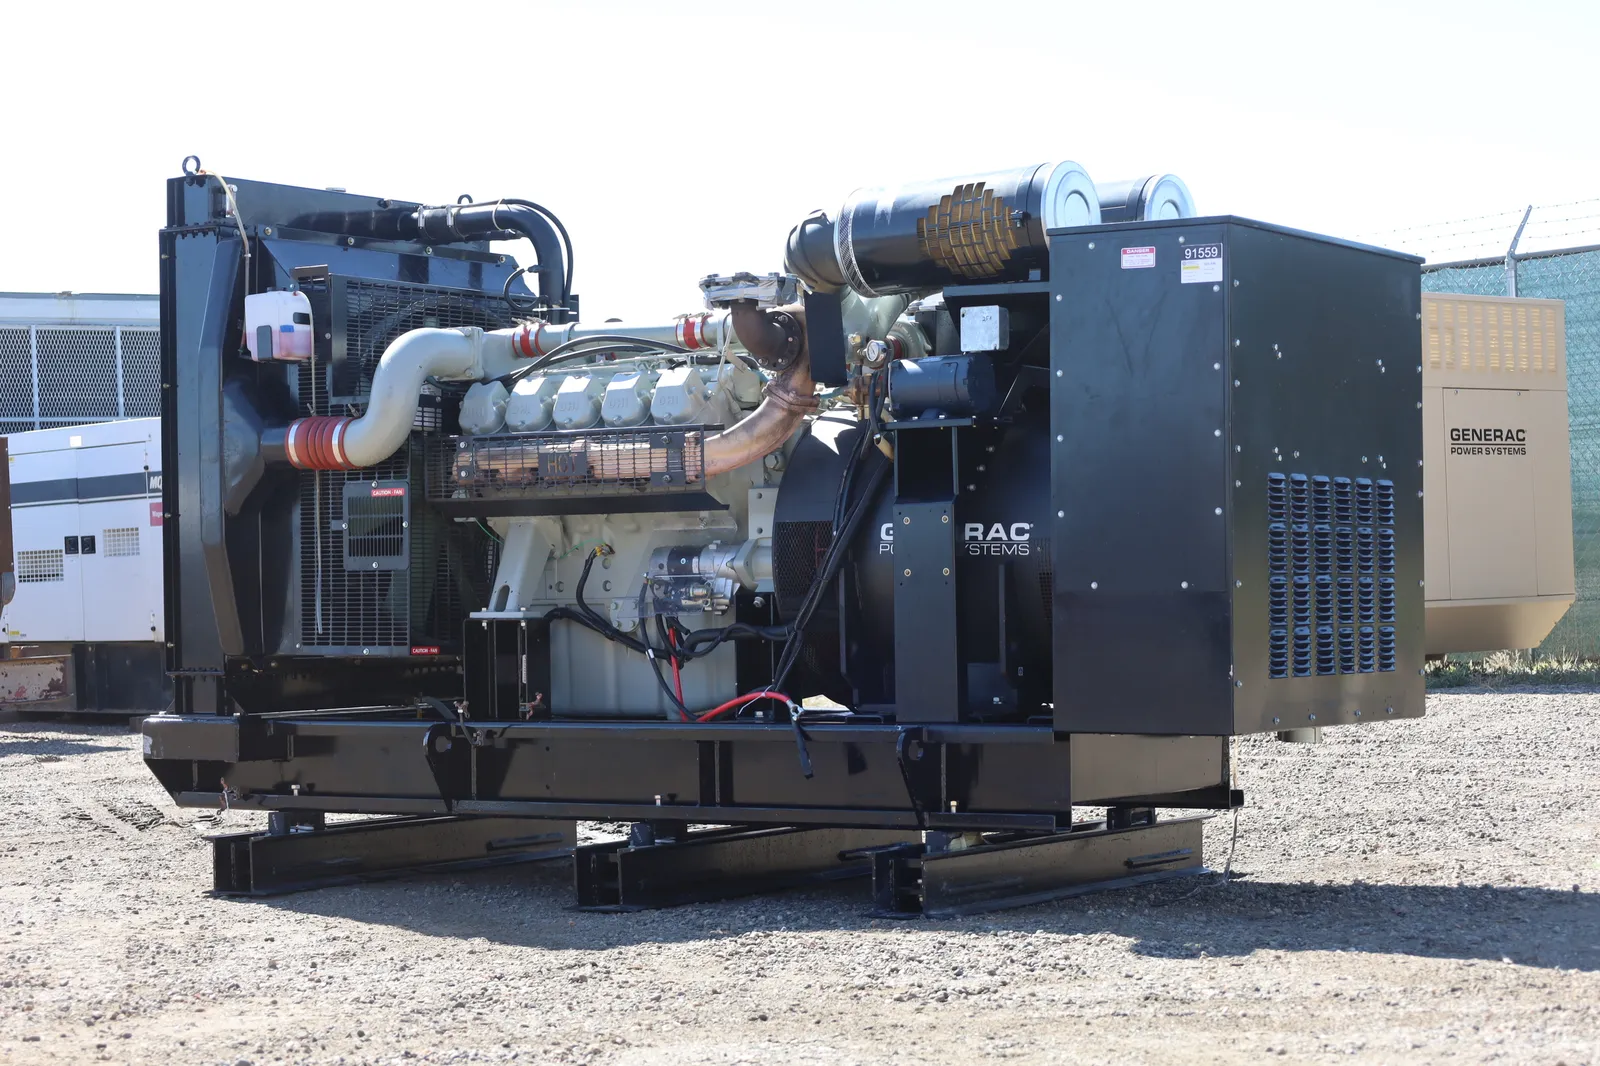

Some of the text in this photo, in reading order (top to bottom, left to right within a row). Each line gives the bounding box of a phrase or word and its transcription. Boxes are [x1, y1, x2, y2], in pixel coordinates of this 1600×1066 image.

[1184, 246, 1218, 259] 91559
[1450, 428, 1526, 441] GENERAC
[1450, 446, 1527, 456] POWER SYSTEMS
[880, 522, 1030, 541] GRAC
